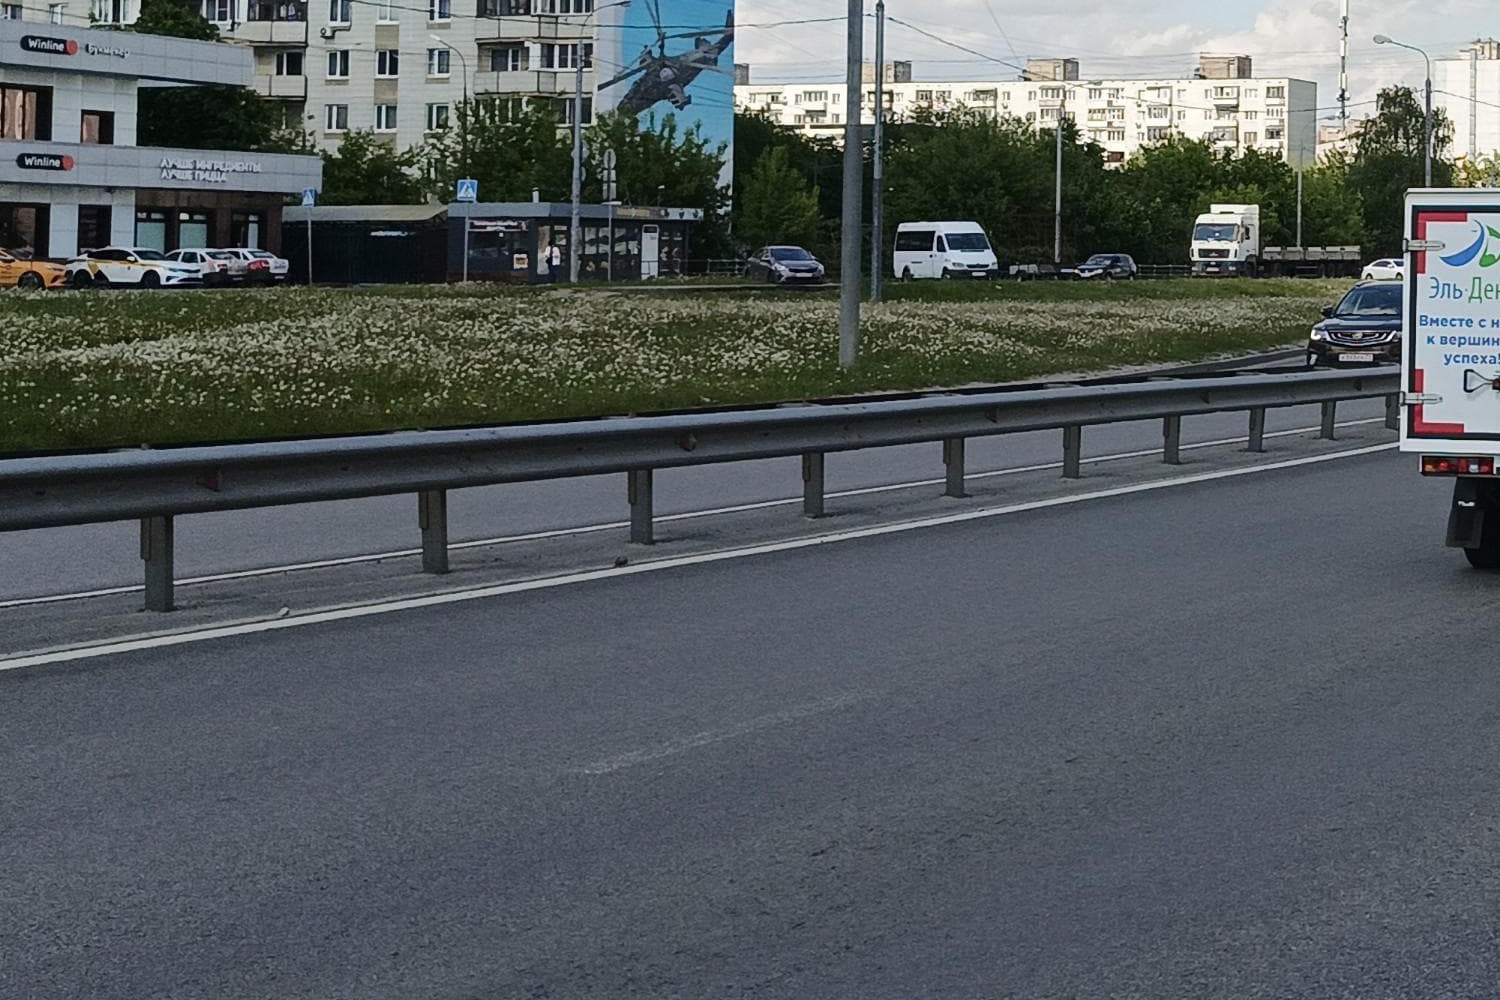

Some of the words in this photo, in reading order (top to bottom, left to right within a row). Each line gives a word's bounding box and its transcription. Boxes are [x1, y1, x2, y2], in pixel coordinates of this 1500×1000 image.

[28, 38, 65, 52] Winline
[24, 155, 61, 168] Winline
[1420, 315, 1474, 328] Вместе
[1478, 318, 1487, 328] с
[1427, 335, 1436, 345] к
